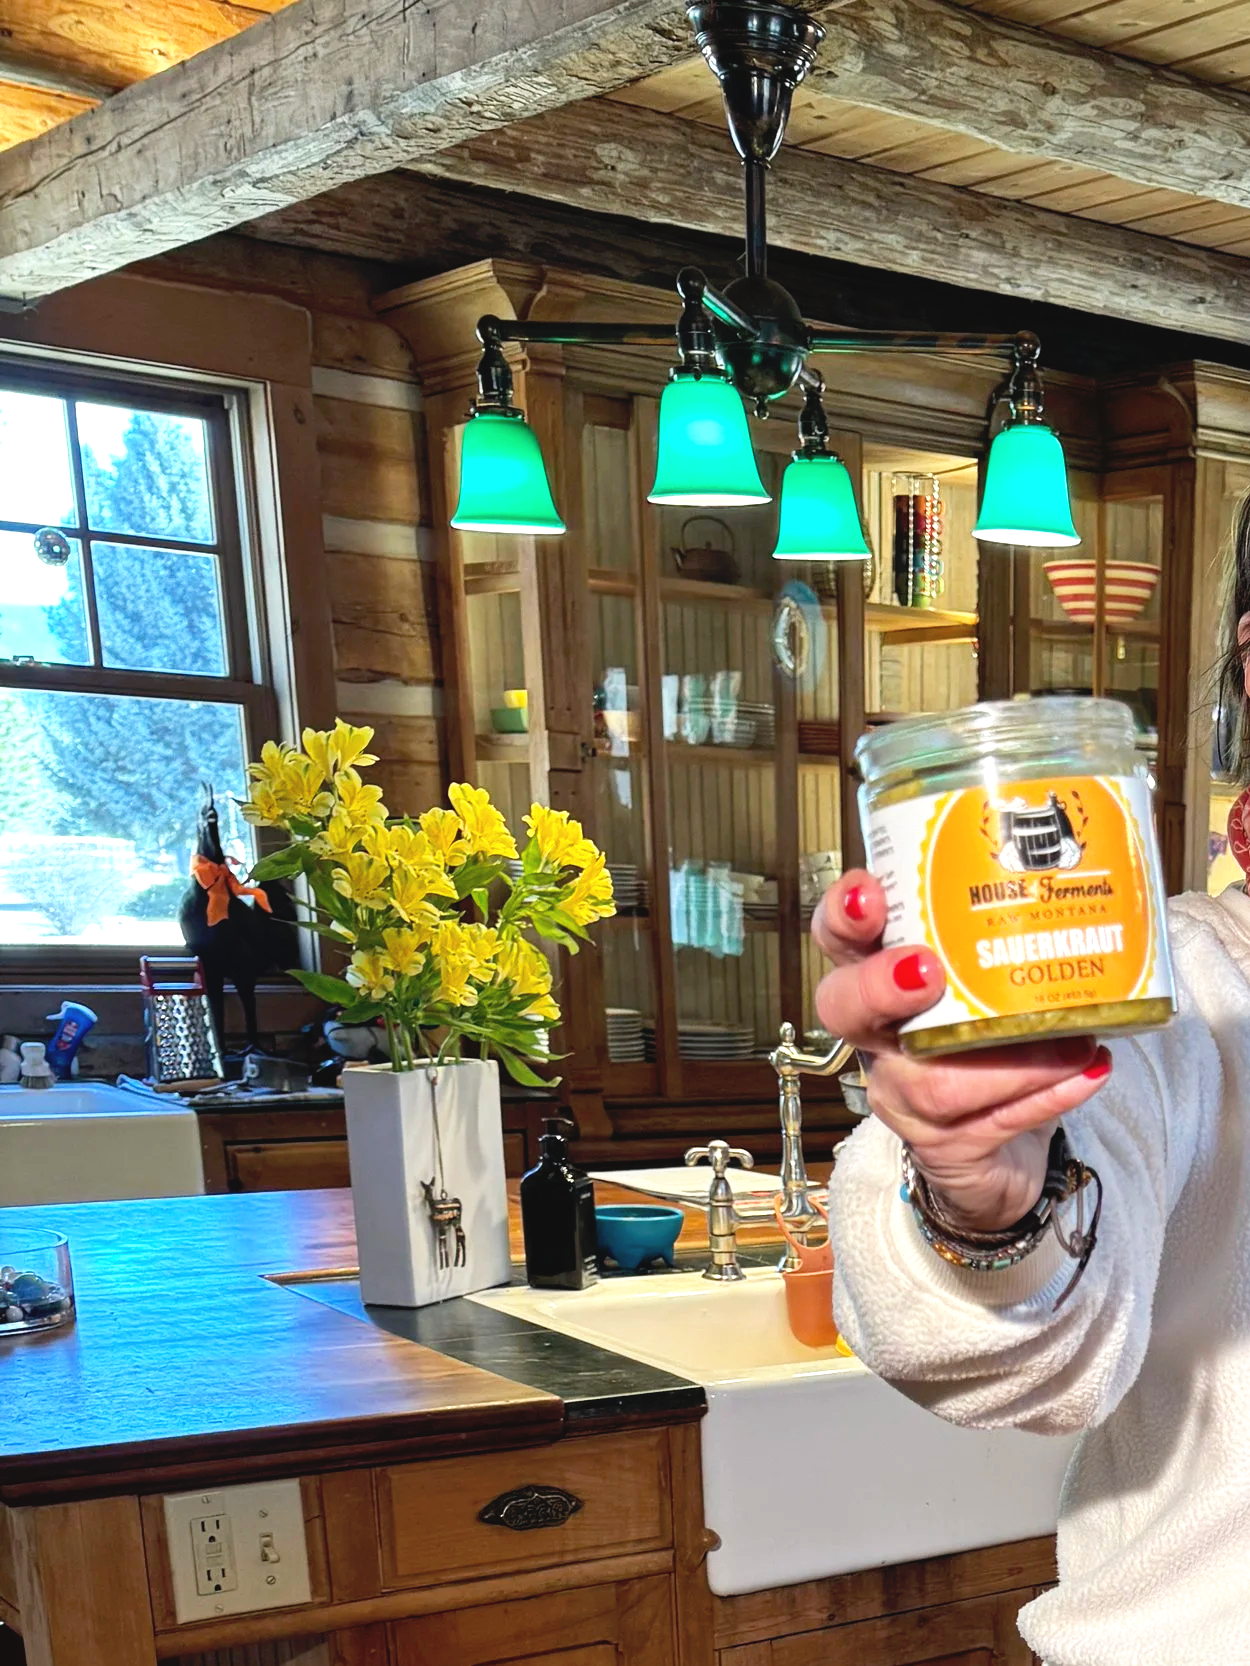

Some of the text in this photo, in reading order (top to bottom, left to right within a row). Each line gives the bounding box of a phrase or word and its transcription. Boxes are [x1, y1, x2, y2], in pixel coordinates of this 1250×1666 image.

[969, 878, 1028, 907] HOUSE
[1040, 876, 1113, 903] Ferments
[986, 905, 1108, 927] RAW MONTANA
[976, 924, 1124, 969] SAUERKRAUT
[1010, 958, 1106, 987] GOLDEN
